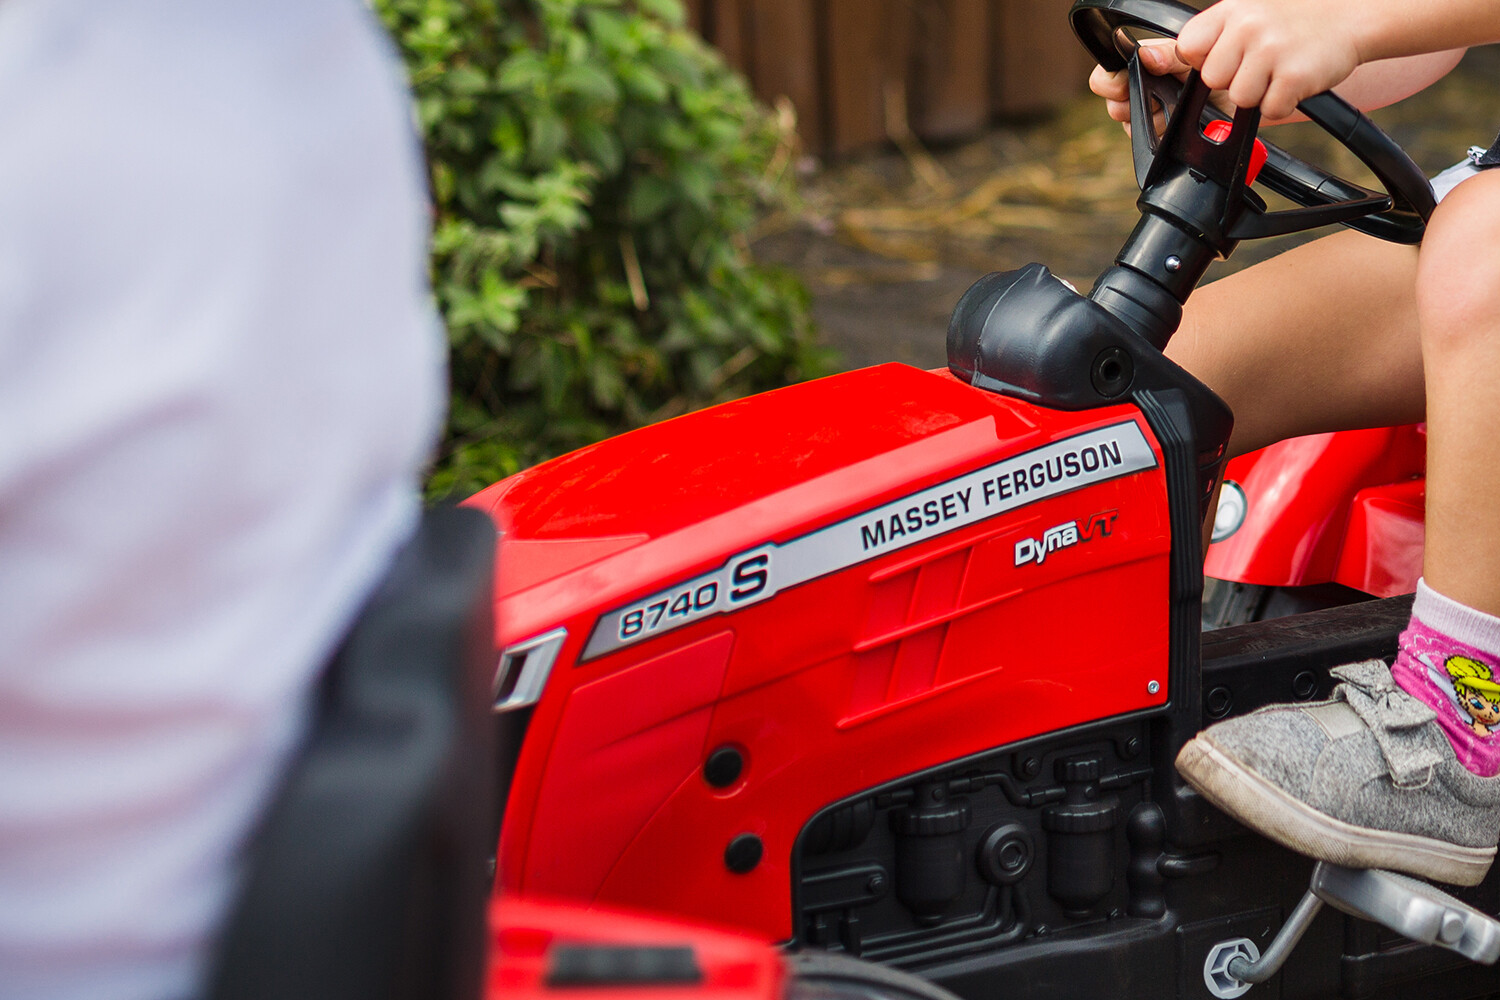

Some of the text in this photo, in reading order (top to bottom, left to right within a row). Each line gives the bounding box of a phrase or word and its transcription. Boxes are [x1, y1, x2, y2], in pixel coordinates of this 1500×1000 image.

[860, 440, 1122, 551] MASSEY FERGUSON
[620, 553, 768, 640] 8740 S
